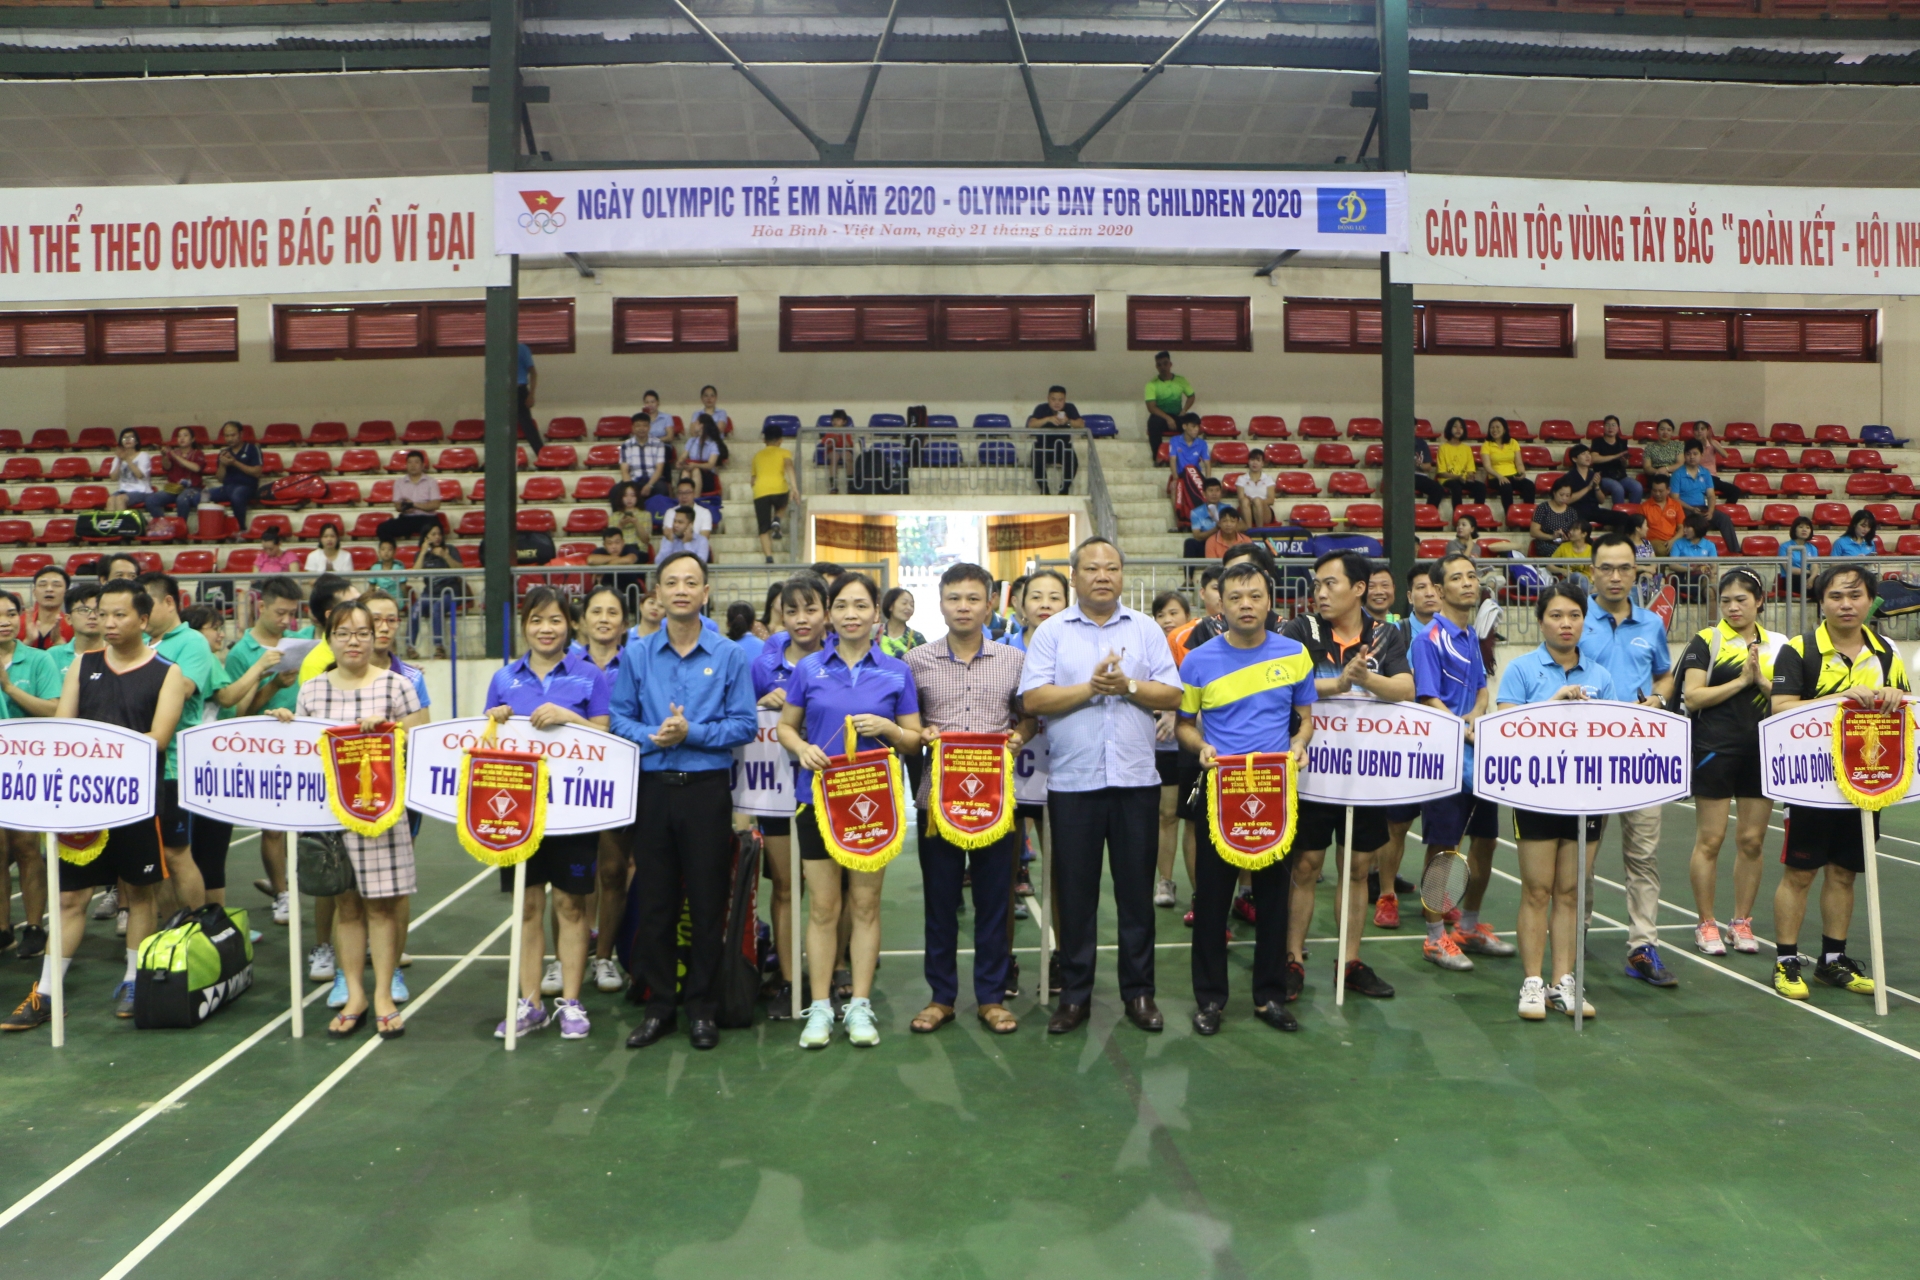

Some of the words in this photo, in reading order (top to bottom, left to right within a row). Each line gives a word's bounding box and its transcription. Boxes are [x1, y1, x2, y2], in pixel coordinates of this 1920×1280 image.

[577, 182, 633, 220] NGÀY
[642, 186, 734, 219] OLYMPIC
[741, 176, 780, 217] TRẺ
[788, 186, 819, 216] EM
[827, 180, 877, 216] NĂM
[884, 185, 936, 216] 2020
[958, 185, 1050, 216] OLYMPIC
[1058, 186, 1095, 216] DAY
[1103, 187, 1140, 217] FOR
[1147, 188, 1245, 218] CHILDREN
[1252, 188, 1302, 219] 2020
[30, 203, 83, 273] THỂ
[91, 222, 161, 272] THEO
[172, 215, 268, 270] GƯƠNG
[278, 206, 335, 266] BÁC
[345, 198, 382, 264] HỒ
[392, 203, 419, 262] VĨ
[427, 211, 475, 272] ĐẠI
[751, 223, 784, 238] Hòa
[789, 222, 828, 238] Bình
[844, 222, 875, 240] Việt
[879, 223, 922, 239] Nam,
[927, 225, 966, 240] ngày
[970, 223, 987, 237] 21
[993, 222, 1039, 240] tháng
[1045, 223, 1054, 237] 6
[1057, 222, 1093, 237] năm
[1097, 223, 1134, 238] 2020
[1426, 199, 1468, 256] CÁC
[1474, 201, 1518, 258] DÂN
[1524, 203, 1562, 270] TỘC
[1568, 206, 1624, 262] VÙNG
[1630, 206, 1667, 262] TÂY
[1674, 202, 1714, 264] BẮC
[1800, 204, 1836, 266] KẾT
[1856, 211, 1889, 277] HỘI
[212, 732, 286, 755] CÔNG
[1311, 715, 1348, 731] NG
[1356, 714, 1432, 736] ĐOÀN
[1500, 716, 1578, 738] CÔNG
[1587, 717, 1667, 738] ĐOÀN
[1790, 717, 1833, 739] CÔN
[53, 739, 125, 759] ĐOÀN
[528, 739, 606, 761] ĐOÀN
[1308, 740, 1352, 775] HÒNG
[1357, 748, 1402, 778] UBND
[1407, 742, 1445, 780] TỈNH
[1484, 755, 1523, 791] CỤC
[1528, 749, 1568, 785] Q.LÝ
[1574, 755, 1604, 791] THỊ
[1609, 748, 1682, 785] TRƯỜNG
[1772, 743, 1785, 786] SỞ
[1788, 754, 1808, 784] LAO
[2, 760, 36, 801] BẢO
[43, 768, 63, 808] VỆ
[69, 774, 140, 805] CSSKCB
[194, 760, 218, 804] HỘI
[223, 763, 254, 800] LIÊN
[260, 763, 292, 807] HIỆP
[297, 769, 326, 809] PHỤ
[430, 766, 458, 796] TH
[563, 766, 615, 809] TỈNH
